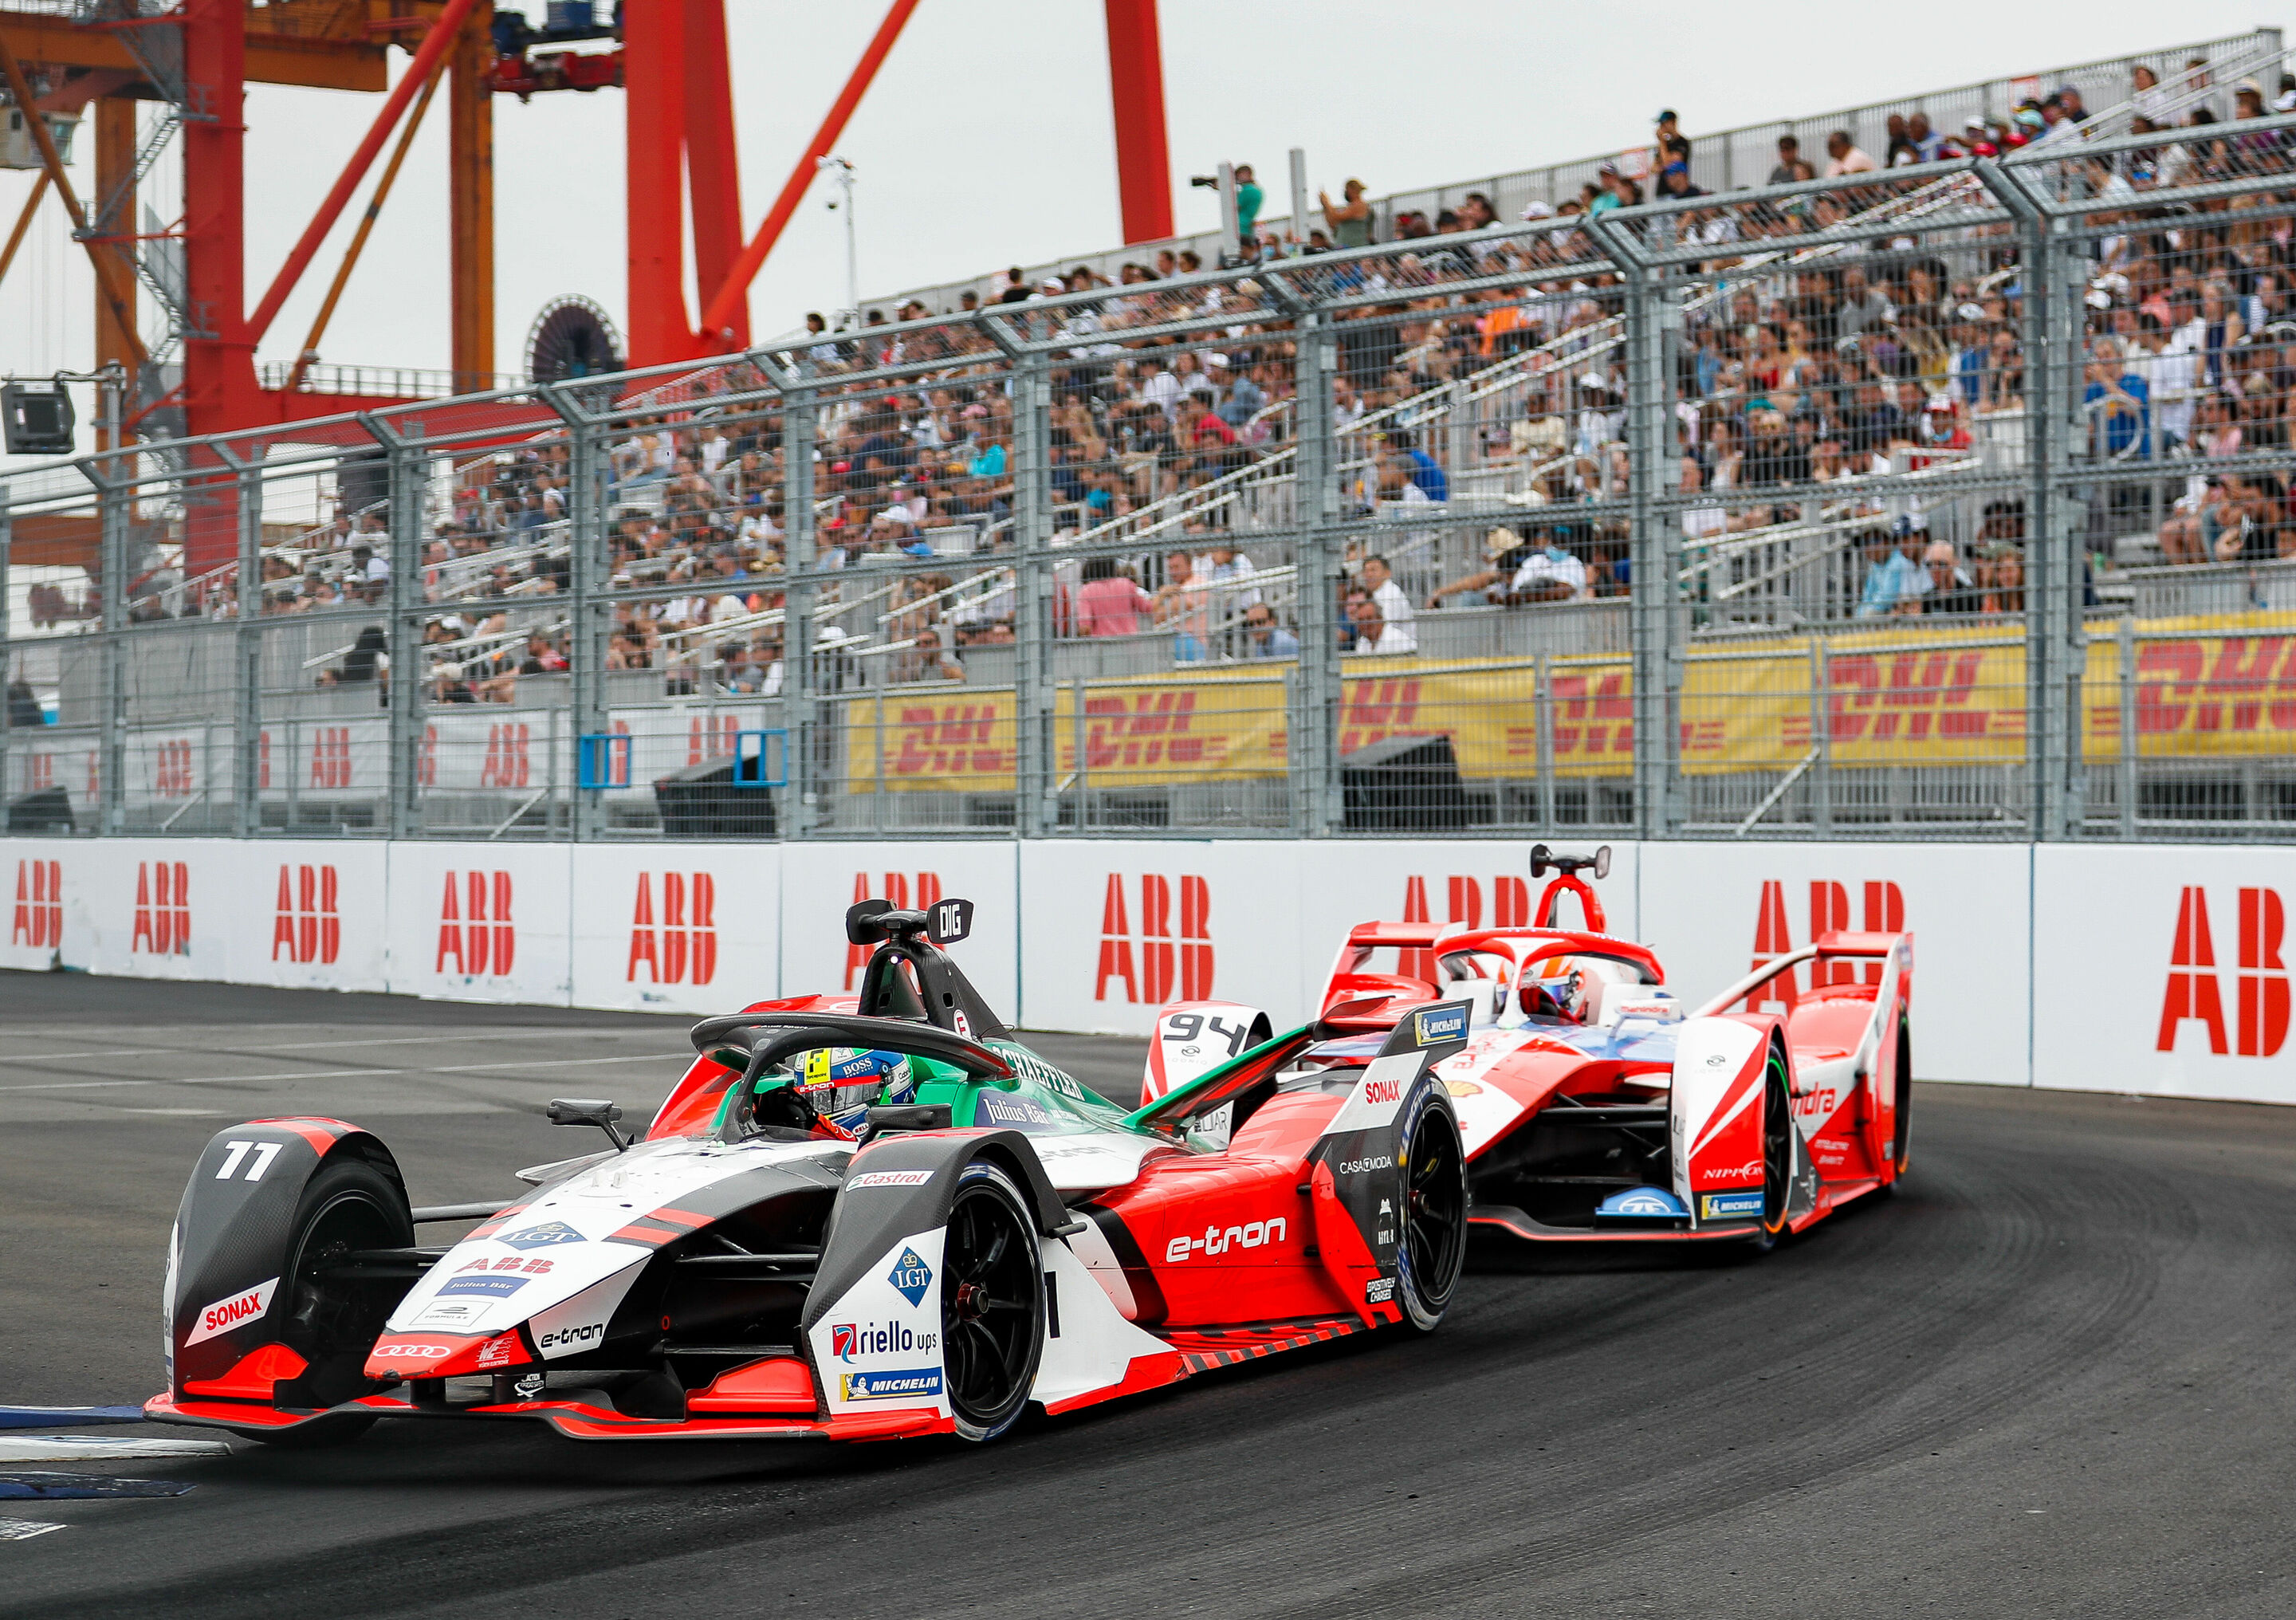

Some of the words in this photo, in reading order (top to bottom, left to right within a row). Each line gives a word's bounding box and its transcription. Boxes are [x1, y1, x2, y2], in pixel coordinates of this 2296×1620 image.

[1817, 654, 1991, 742] DHL
[897, 705, 1001, 773] DHL
[1086, 690, 1204, 769] DHL
[482, 723, 529, 788] ABB
[14, 860, 62, 948] ABB
[132, 862, 191, 955] ABB
[273, 864, 340, 964] ABB
[436, 871, 515, 976] ABB
[939, 903, 961, 938] DIG
[627, 871, 717, 985] ABB
[1095, 873, 1215, 1003] ABB
[2156, 886, 2292, 1057] AB
[1163, 1013, 1247, 1058] 94
[1429, 1018, 1462, 1034] MICHELIN
[842, 1057, 873, 1075] BOSS
[800, 1081, 835, 1093] e-tron
[1365, 1079, 1401, 1104] SONAX
[854, 1123, 870, 1134] BELL
[982, 1098, 1028, 1125] Julius
[1022, 1102, 1051, 1125] Bär
[214, 1140, 284, 1182] 11
[863, 1171, 926, 1186] Castrol
[505, 1231, 577, 1243] LGT
[1166, 1217, 1287, 1264] e-tron
[453, 1257, 555, 1274] ABB
[894, 1268, 929, 1289] LGT
[205, 1292, 262, 1331] SONAX
[541, 1323, 603, 1350] e-tron
[860, 1319, 913, 1355] riello
[916, 1332, 938, 1355] ups
[871, 1375, 939, 1393] MICHELIN
